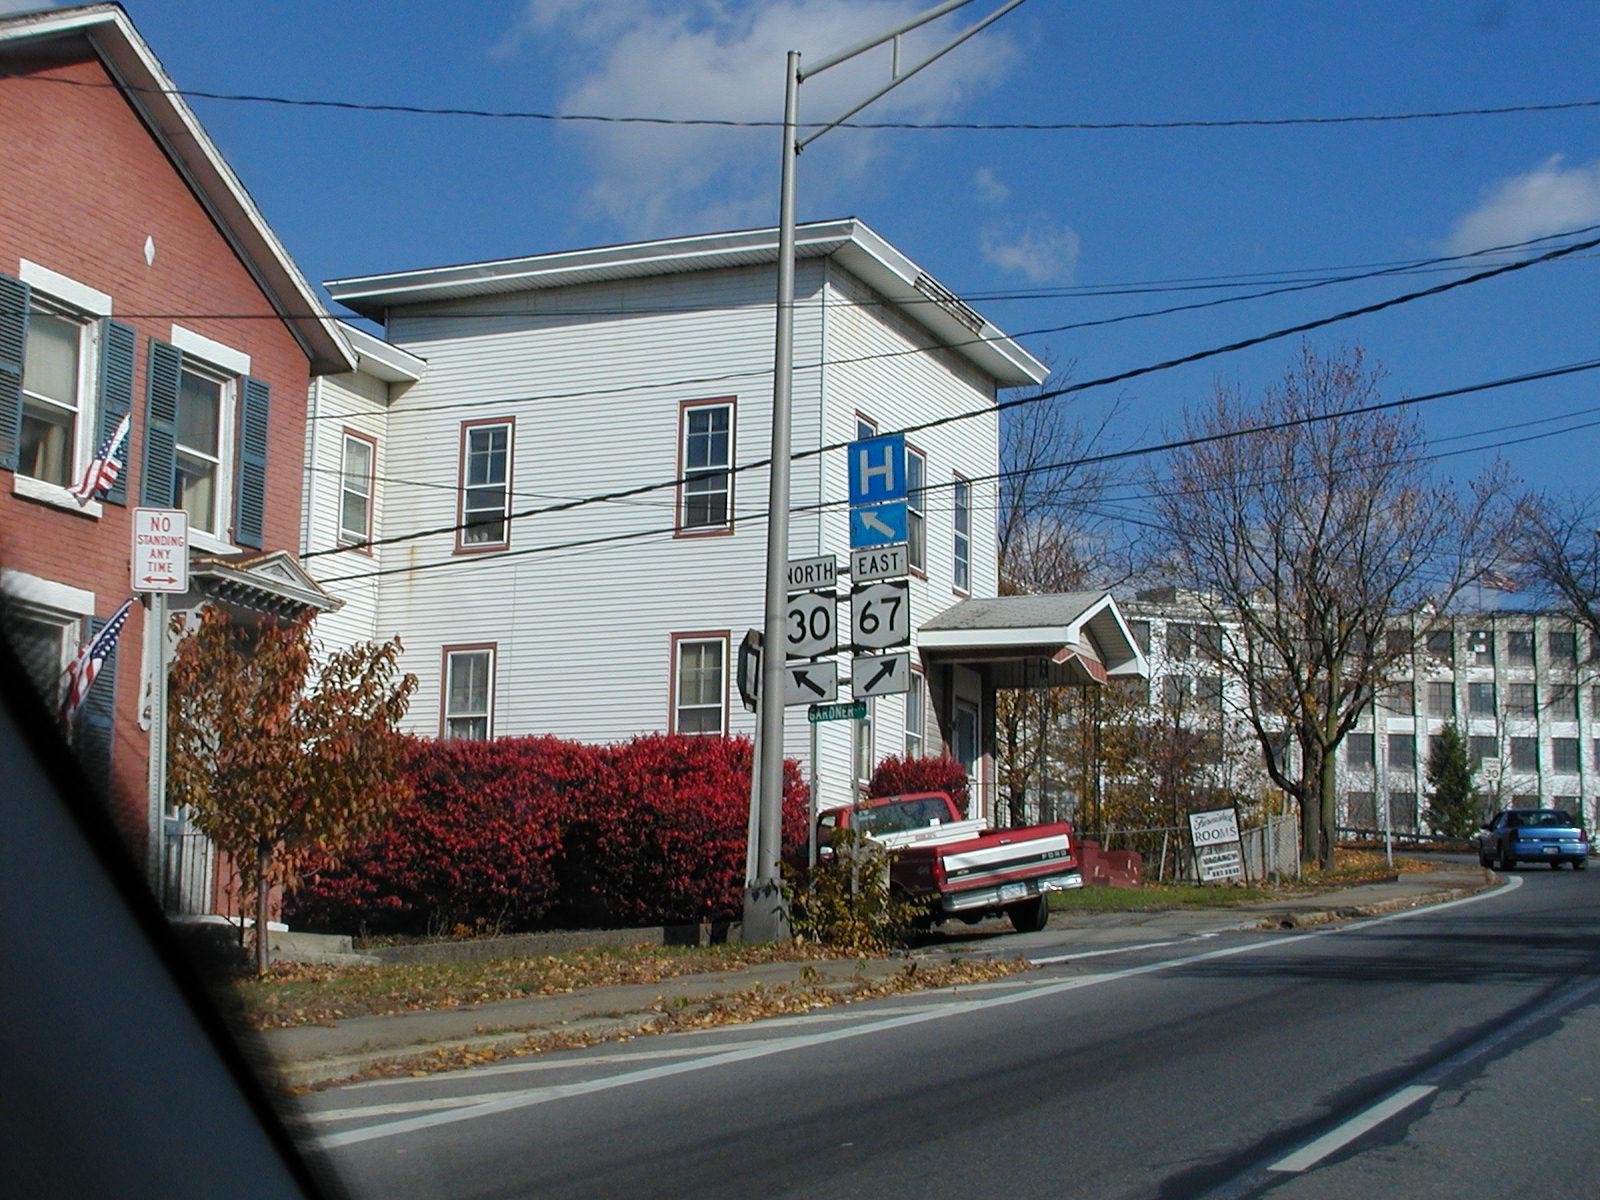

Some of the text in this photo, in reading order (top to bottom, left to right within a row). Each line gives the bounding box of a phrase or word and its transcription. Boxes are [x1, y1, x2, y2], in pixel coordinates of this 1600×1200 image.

[860, 445, 895, 495] H
[150, 516, 171, 532] NO
[137, 534, 185, 547] STANDING
[149, 548, 172, 559] ANY
[147, 561, 173, 573] TIME
[858, 552, 899, 575] EAST
[859, 596, 901, 635] 67
[787, 606, 830, 644] 30
[809, 704, 854, 721] GARDNER
[1194, 826, 1238, 842] ROOMS
[1041, 849, 1067, 860] FORD
